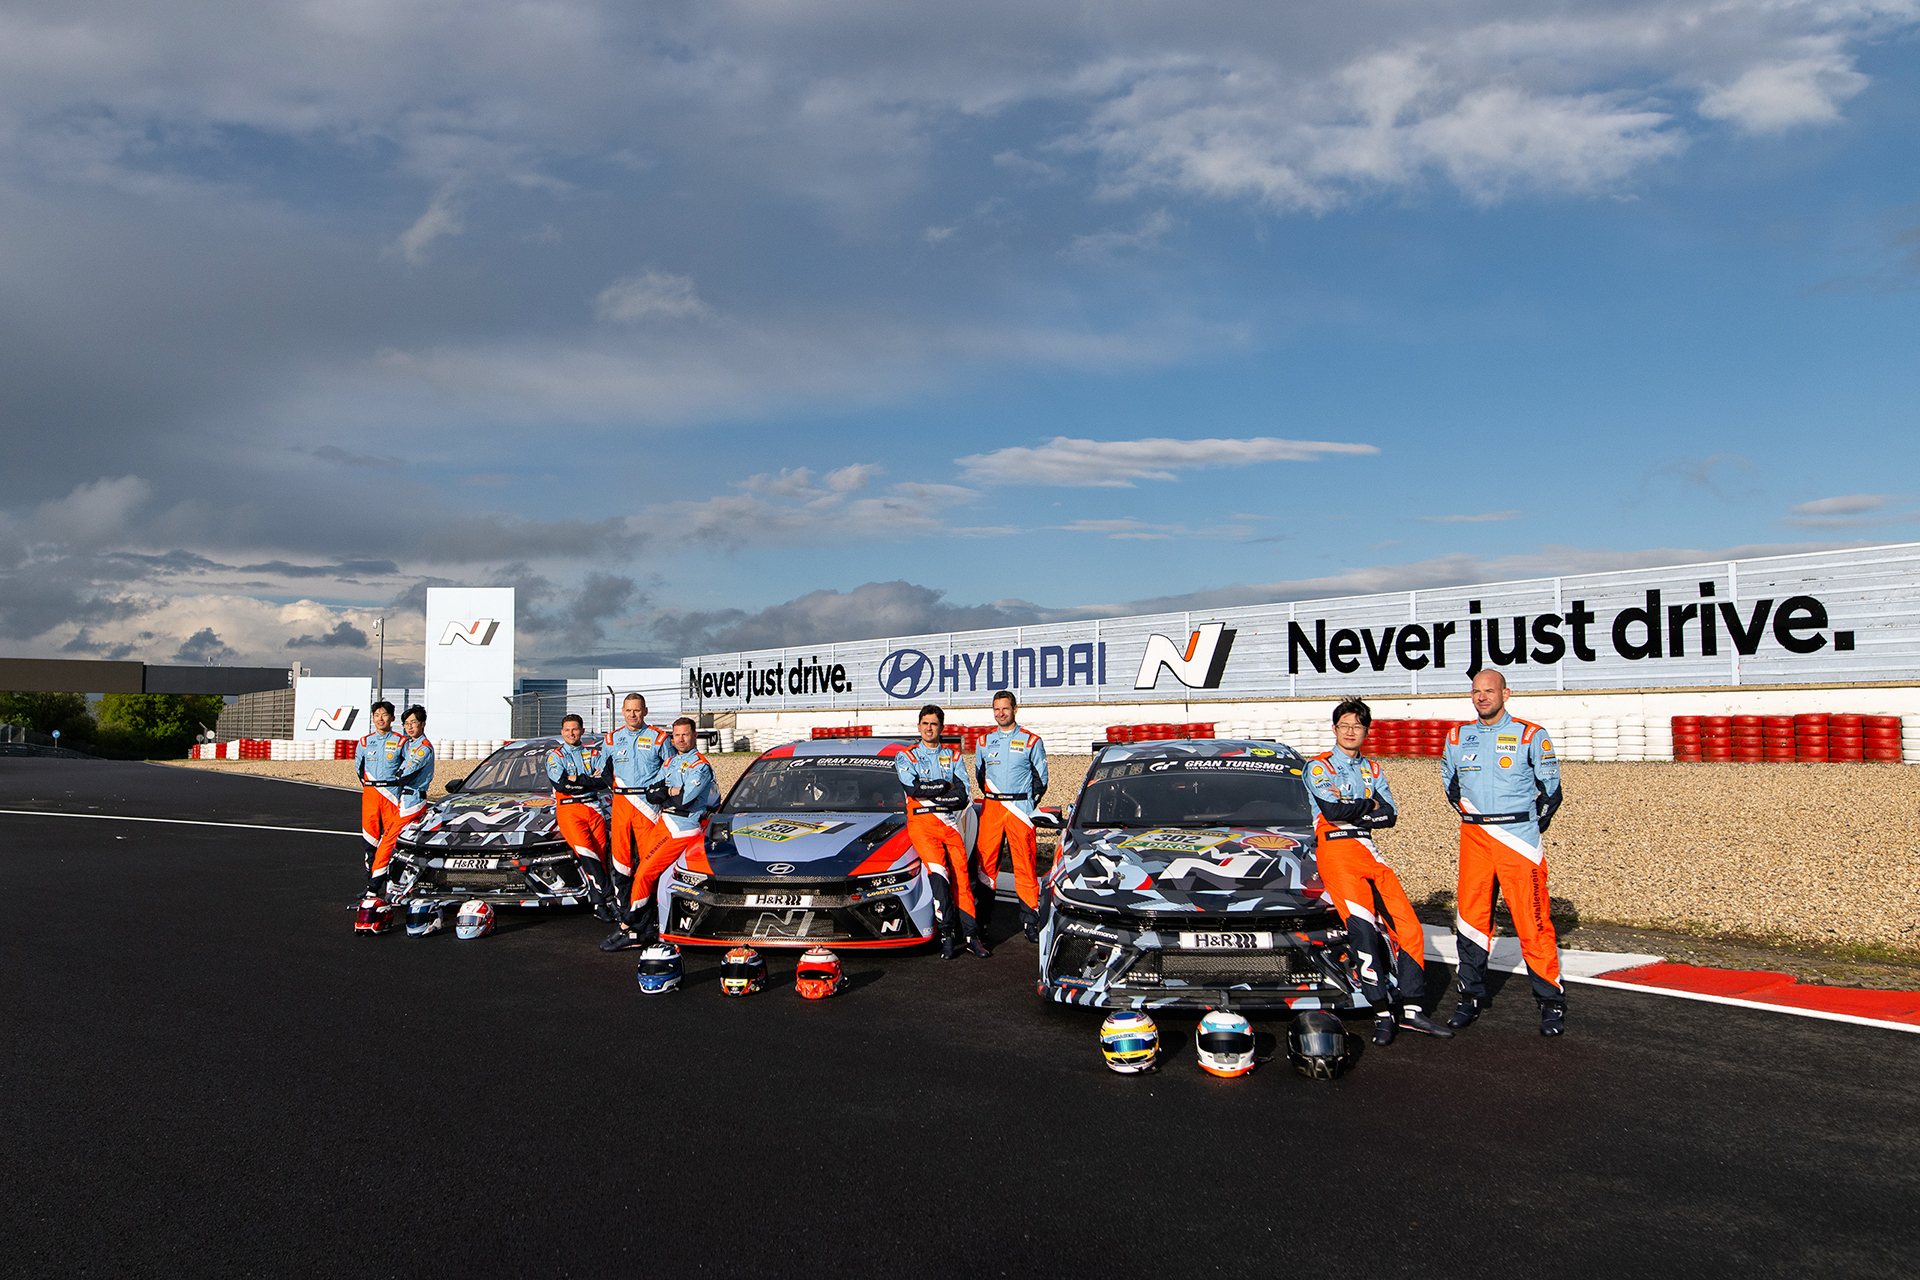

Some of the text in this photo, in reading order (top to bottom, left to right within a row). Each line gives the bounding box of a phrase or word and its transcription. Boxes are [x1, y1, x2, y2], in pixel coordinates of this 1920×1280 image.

[439, 618, 500, 645] N
[1288, 581, 1856, 679] Never just drive.
[1134, 622, 1238, 690] N
[938, 642, 1106, 693] HYUNDAI
[689, 655, 852, 704] Never just drive.
[848, 758, 896, 767] TURISMO
[1184, 760, 1224, 768] GRAN
[750, 831, 782, 841] DEKRA
[1154, 834, 1202, 844] 302
[1145, 842, 1197, 851] DEKRA
[453, 860, 475, 868] H&R
[671, 885, 700, 896] GOODYEAR
[866, 886, 905, 898] GOODYEAR
[756, 894, 785, 905] H&R
[1530, 868, 1544, 932] M.Wallenwein
[1080, 925, 1119, 940] Performance
[1196, 934, 1233, 947] H&R
